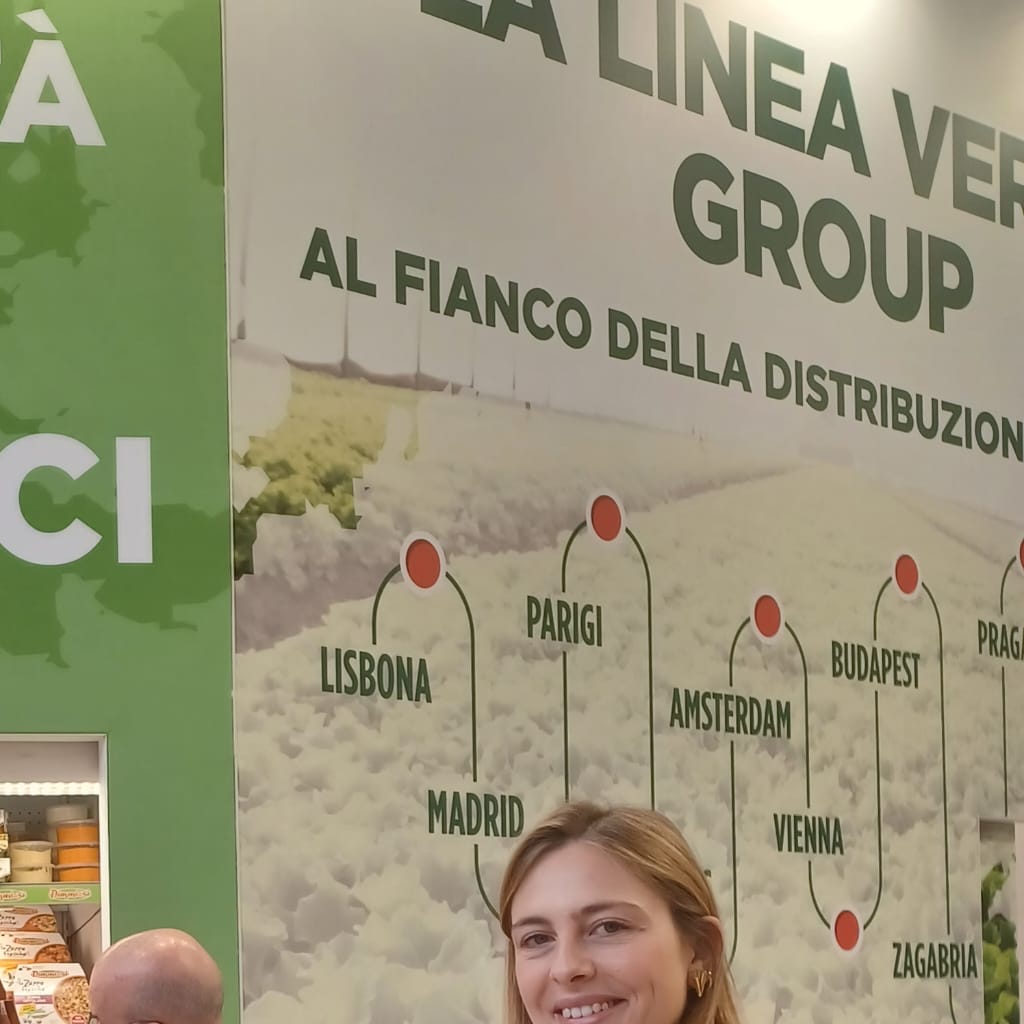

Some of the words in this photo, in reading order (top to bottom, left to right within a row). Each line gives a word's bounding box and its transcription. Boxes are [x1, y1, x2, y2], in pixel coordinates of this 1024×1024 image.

[598, 0, 871, 178] LINEA
[673, 153, 974, 334] GROUP
[299, 227, 376, 298] AL
[394, 249, 592, 350] FIANCO
[608, 308, 751, 393] DELLA
[764, 352, 1024, 462] DISTRIBUZION
[526, 595, 603, 648] PARIGI
[321, 646, 432, 704] LISBONA
[830, 640, 920, 689] BUDAPEST
[669, 687, 792, 740] AMSTERDAM
[427, 789, 525, 838] MADRID
[774, 812, 844, 856] VIENNA
[893, 942, 978, 979] ZAGABRIA
